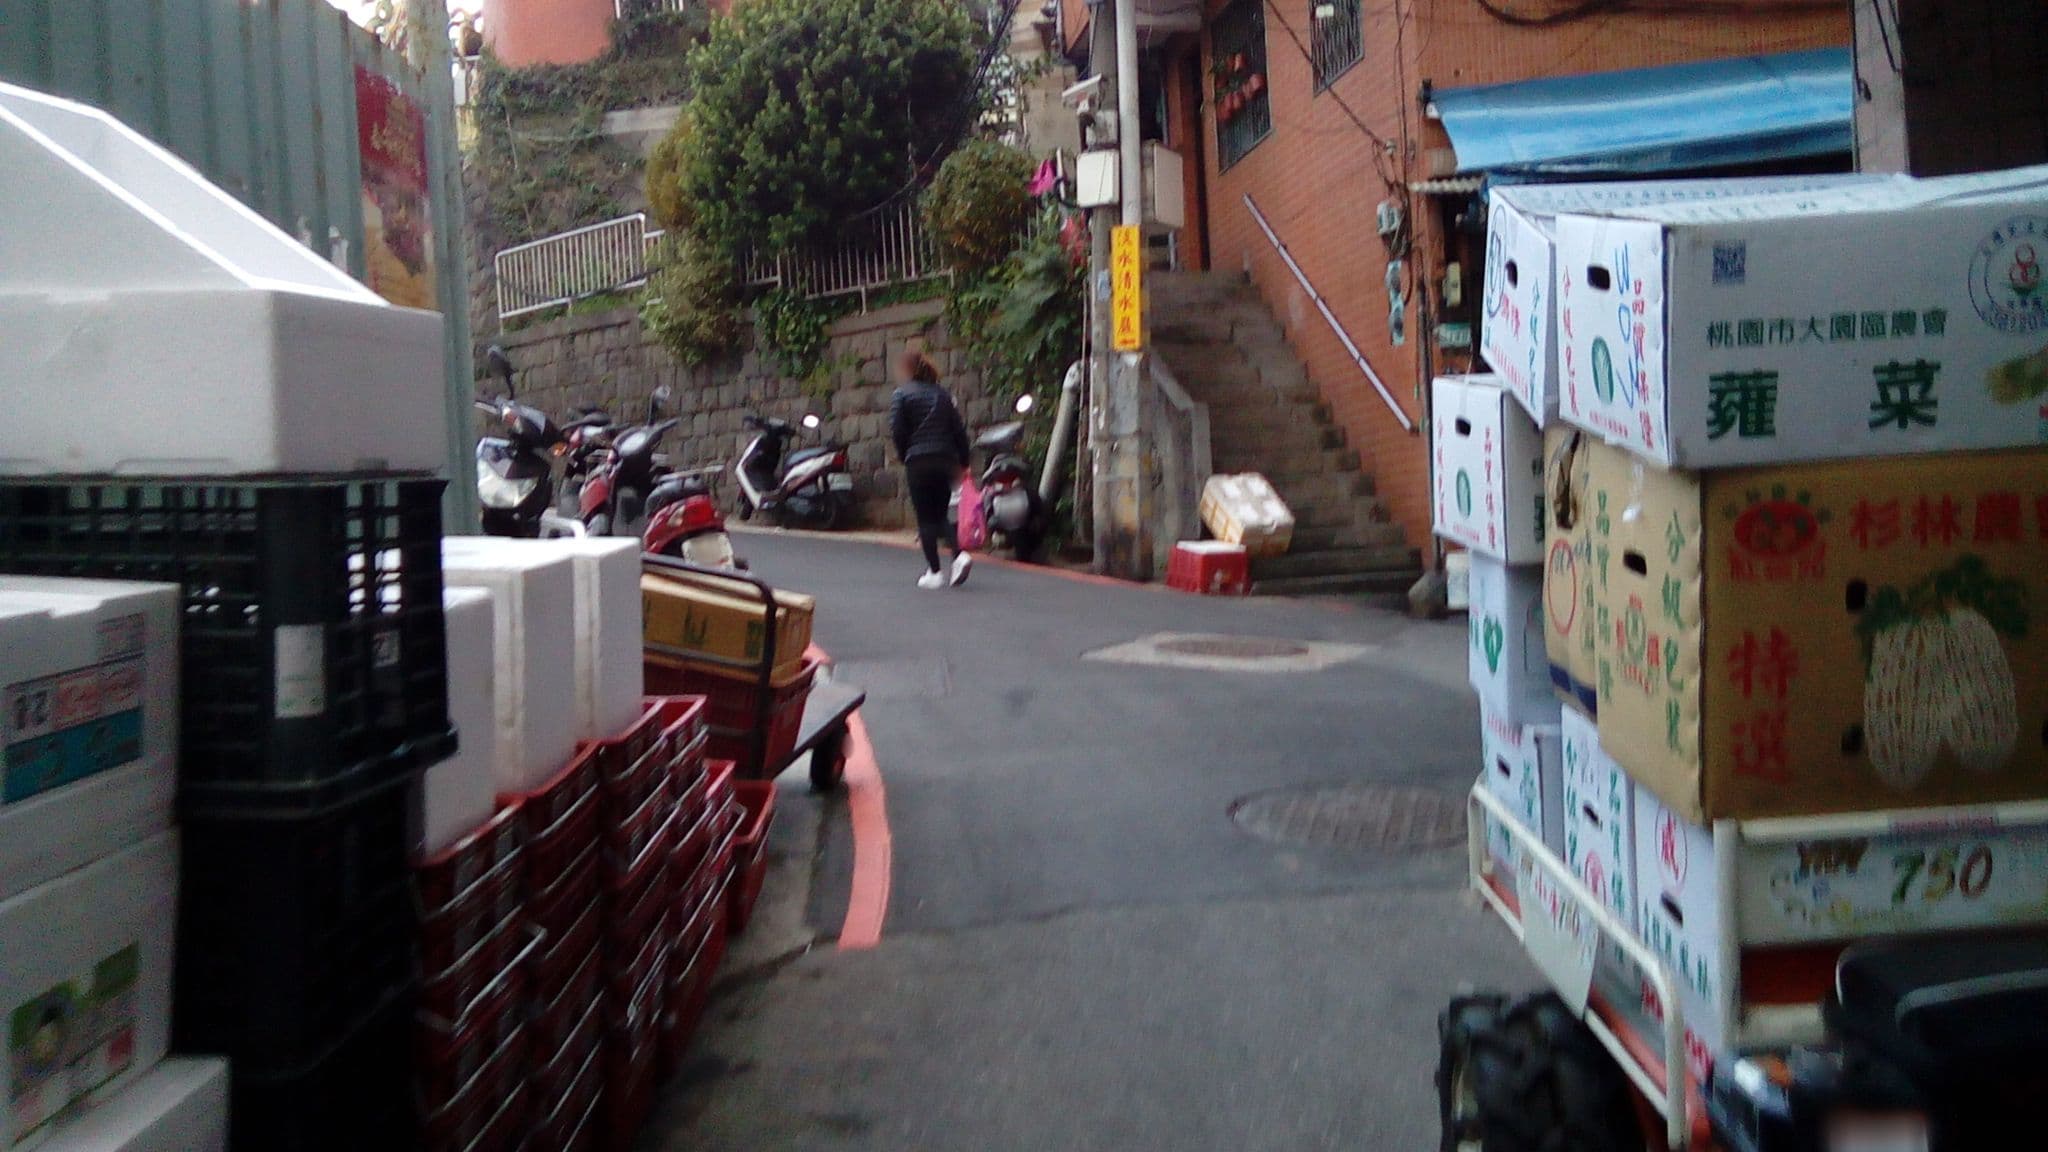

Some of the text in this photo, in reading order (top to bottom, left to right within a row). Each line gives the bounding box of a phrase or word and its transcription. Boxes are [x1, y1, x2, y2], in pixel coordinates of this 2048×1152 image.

[1706, 307, 1947, 349] 桃園市大園區農會
[1848, 490, 2048, 549] 杉林農
[1889, 841, 1993, 904] 750
